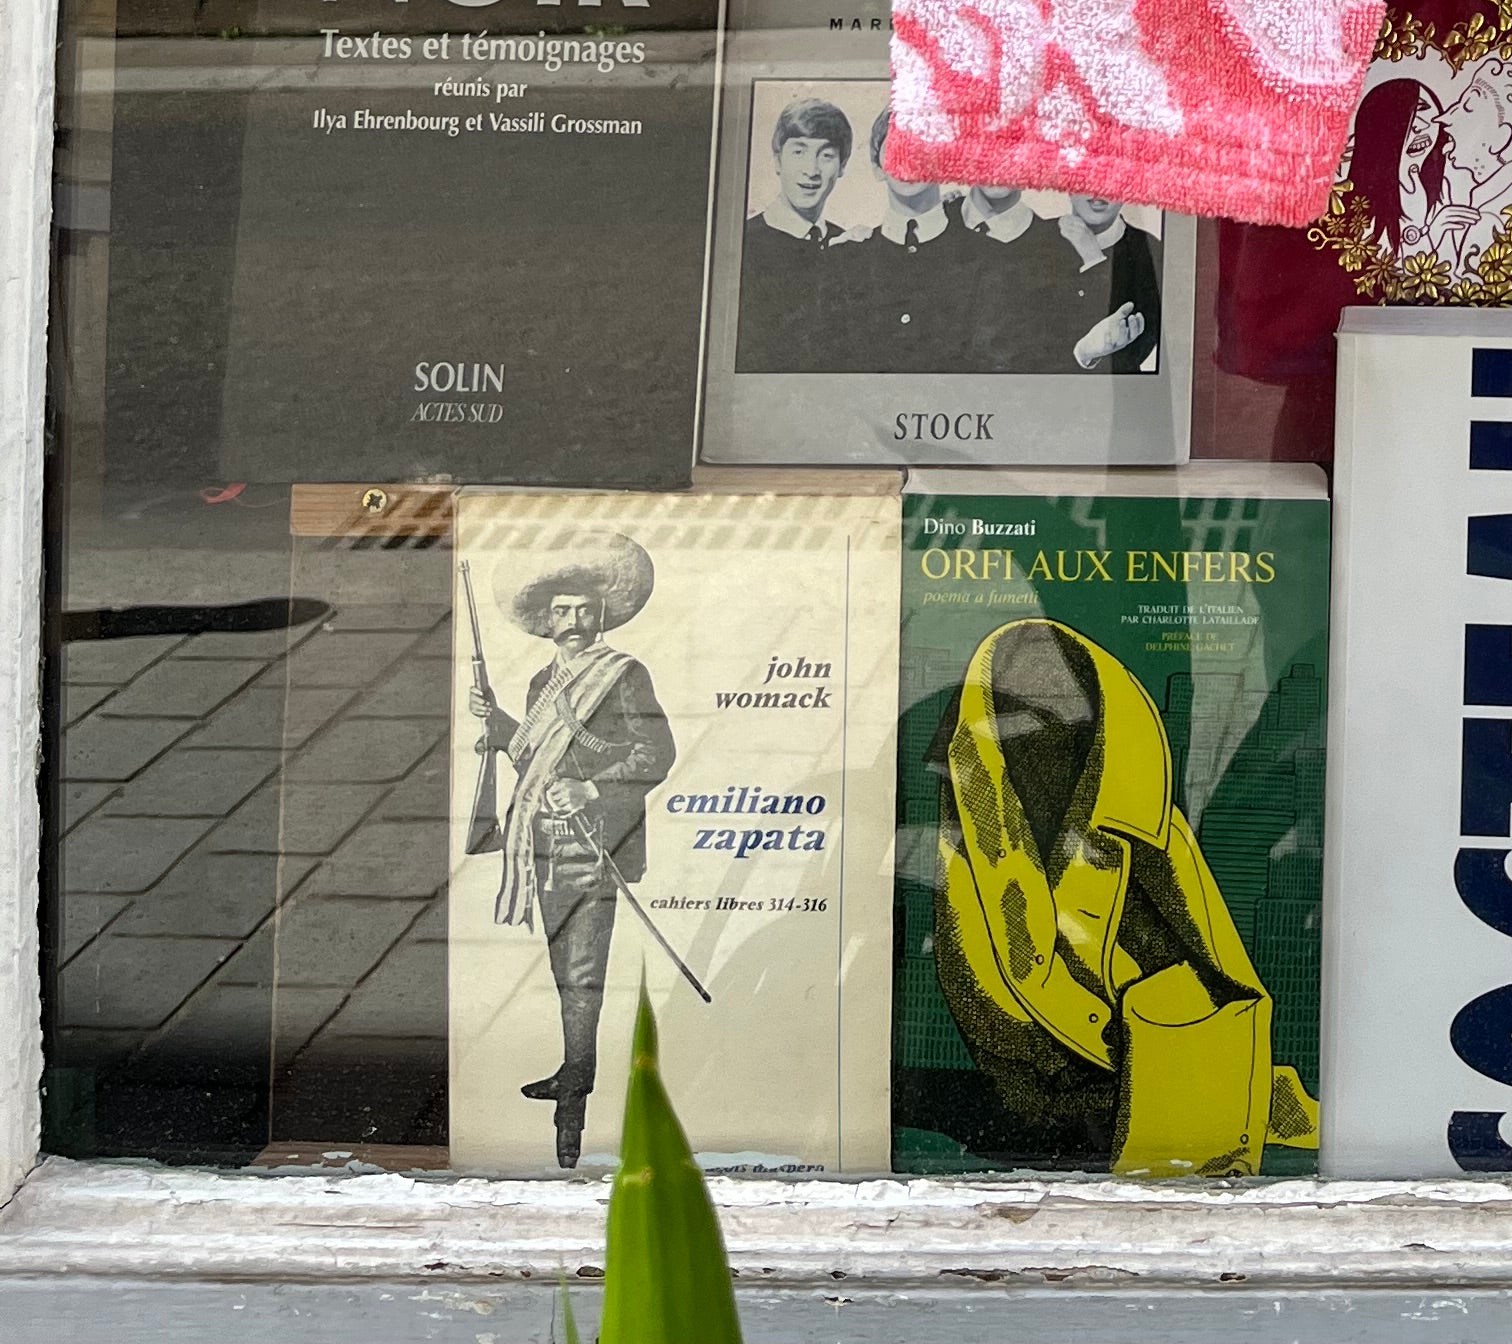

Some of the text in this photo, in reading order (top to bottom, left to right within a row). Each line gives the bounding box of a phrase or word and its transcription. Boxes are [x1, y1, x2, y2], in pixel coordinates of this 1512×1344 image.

[320, 28, 646, 73] Textes et témoignages
[434, 76, 528, 103] réunis par
[313, 108, 643, 137] Ilya Ehrenbourg et Vassili Grossman
[413, 361, 505, 394] SOLIN
[410, 402, 504, 424] ACTES SUD
[893, 412, 995, 441] STOCK
[923, 518, 1037, 537] Dino Buzzati
[920, 547, 1276, 584] ORFI AUX ENFERS
[922, 591, 1039, 609] poema a fumetti
[1120, 615, 1261, 625] PAR CHARLOTTE LATAILLADE
[763, 656, 832, 685] john
[715, 686, 832, 710] womack
[666, 785, 827, 815] emiliano
[692, 824, 826, 859] zapata
[650, 896, 828, 913] cahiers libres 314-316
